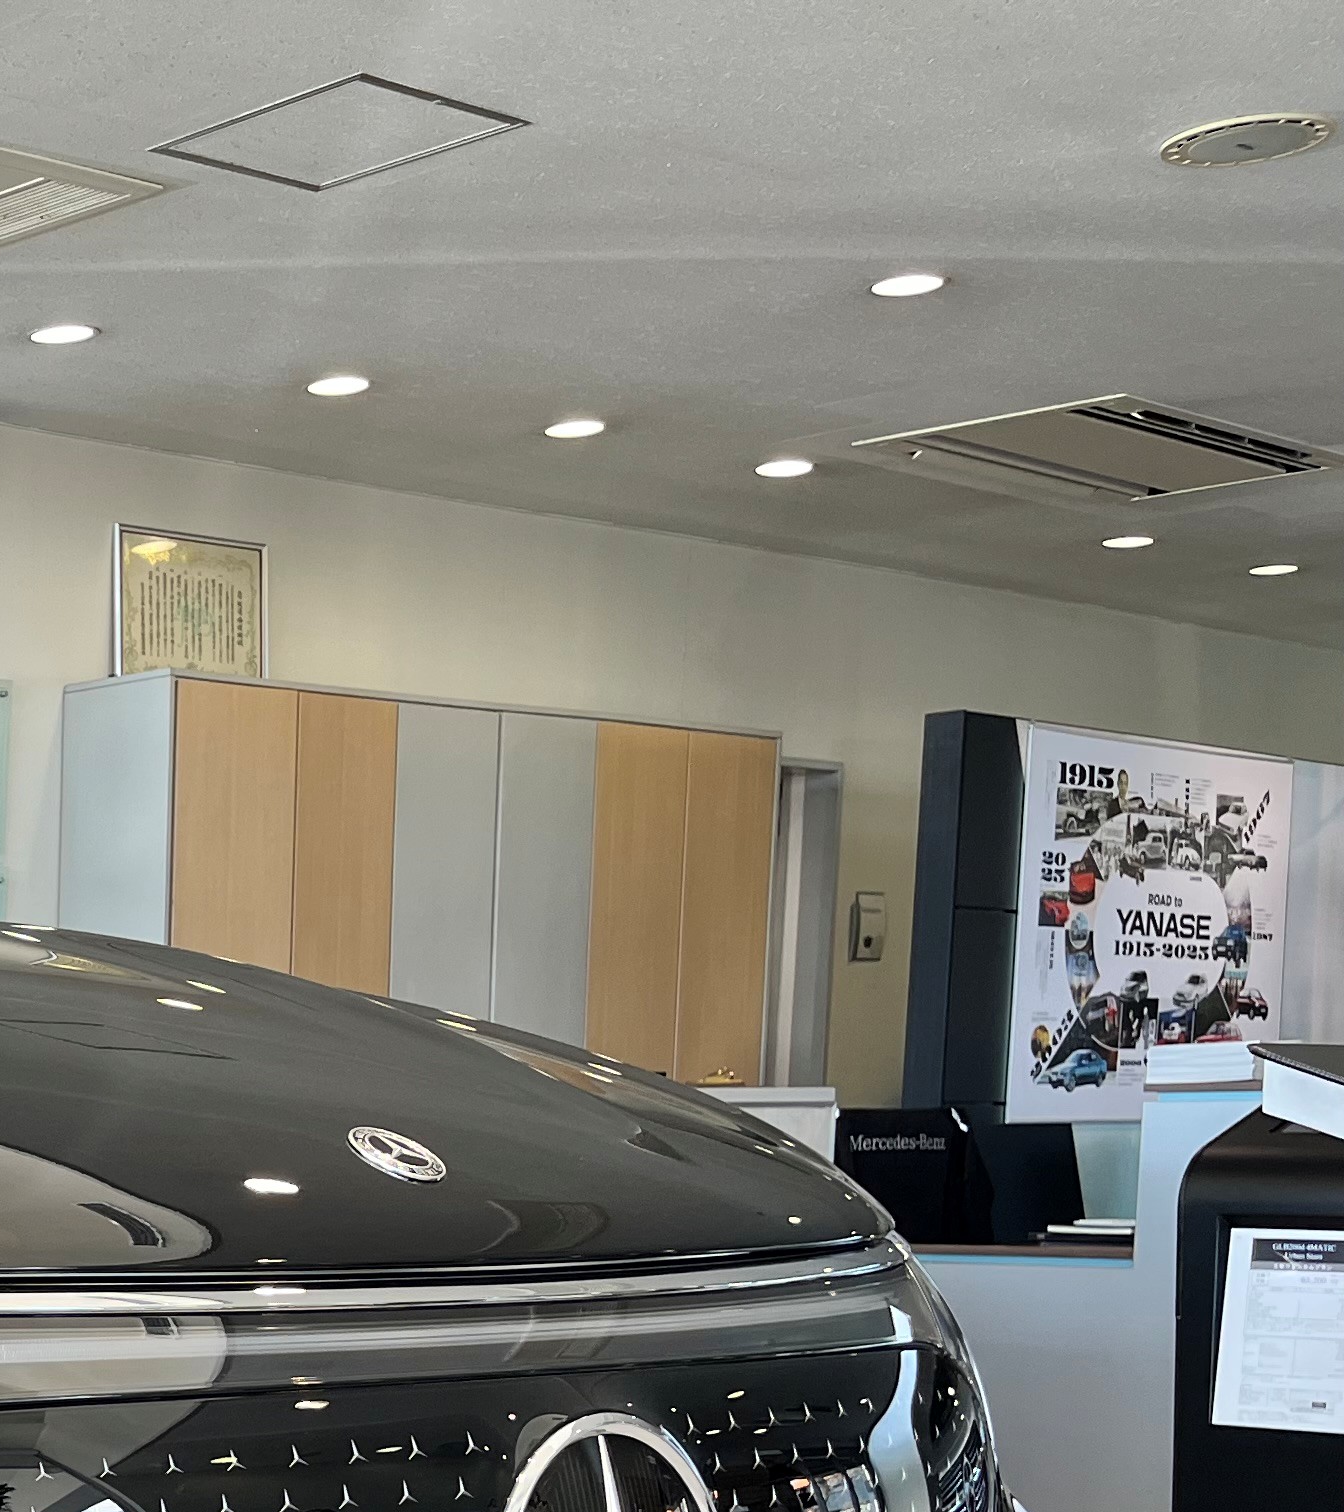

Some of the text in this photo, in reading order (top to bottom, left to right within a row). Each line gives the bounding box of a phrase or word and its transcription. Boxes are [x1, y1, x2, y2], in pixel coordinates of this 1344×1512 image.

[1058, 760, 1115, 789] 1915
[1041, 850, 1067, 867] 20
[1040, 866, 1066, 883] 25
[1147, 893, 1183, 908] ROAD to
[1116, 908, 1212, 940] YANASE
[1114, 939, 1210, 961] 1915-2025
[849, 1132, 947, 1152] Mercedes-Benz
